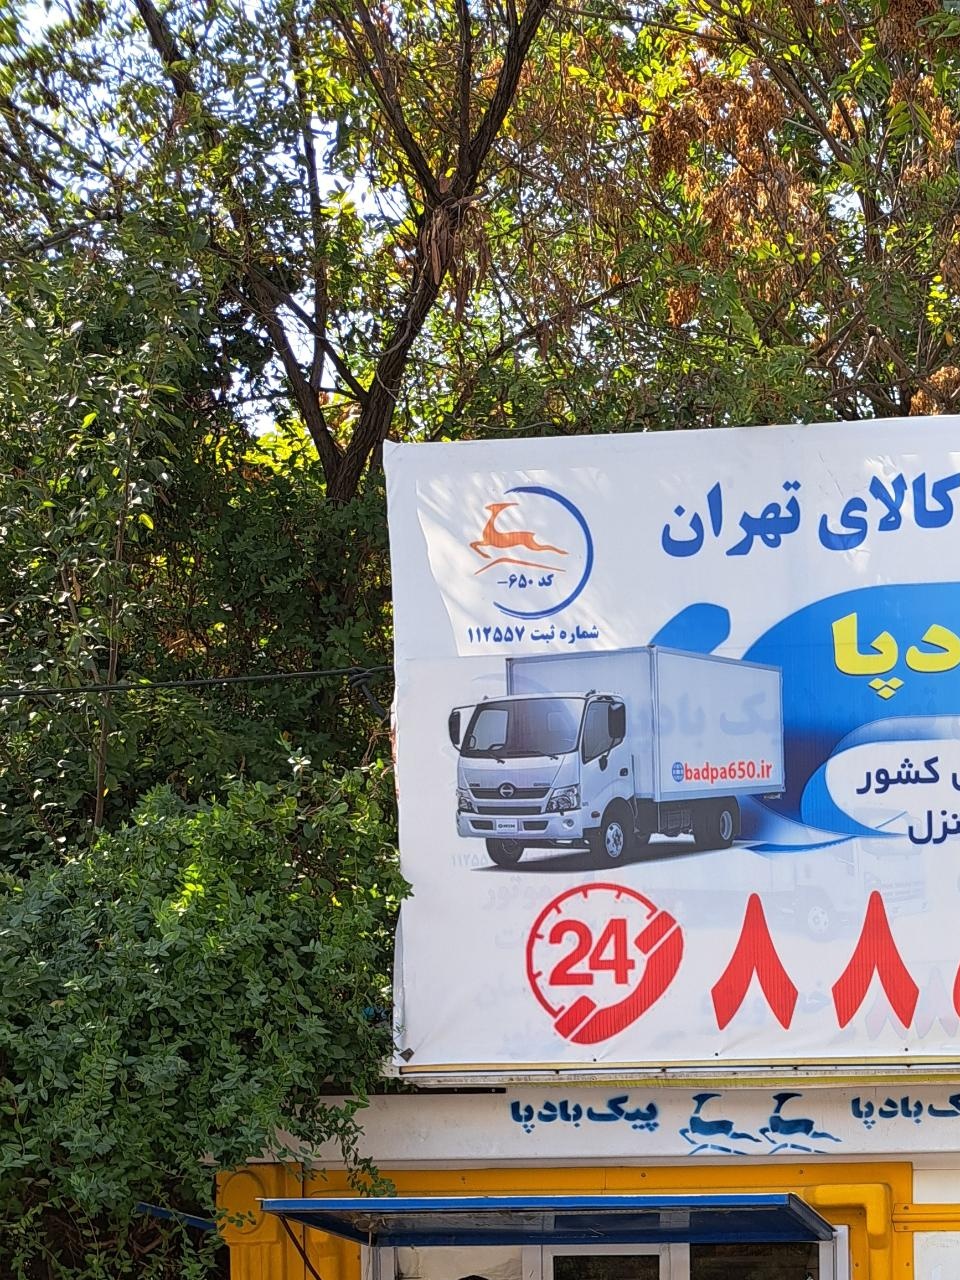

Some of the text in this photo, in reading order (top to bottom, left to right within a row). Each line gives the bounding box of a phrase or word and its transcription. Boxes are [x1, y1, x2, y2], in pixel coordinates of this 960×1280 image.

[660, 480, 800, 557] تهران
[538, 574, 554, 587] کد
[468, 625, 599, 644] شماره ثبت ۱۱۲۵۵۷
[684, 758, 773, 785] badpa650.ir
[856, 755, 939, 795] کشور
[549, 917, 635, 986] 24
[586, 1094, 659, 1133] پیک
